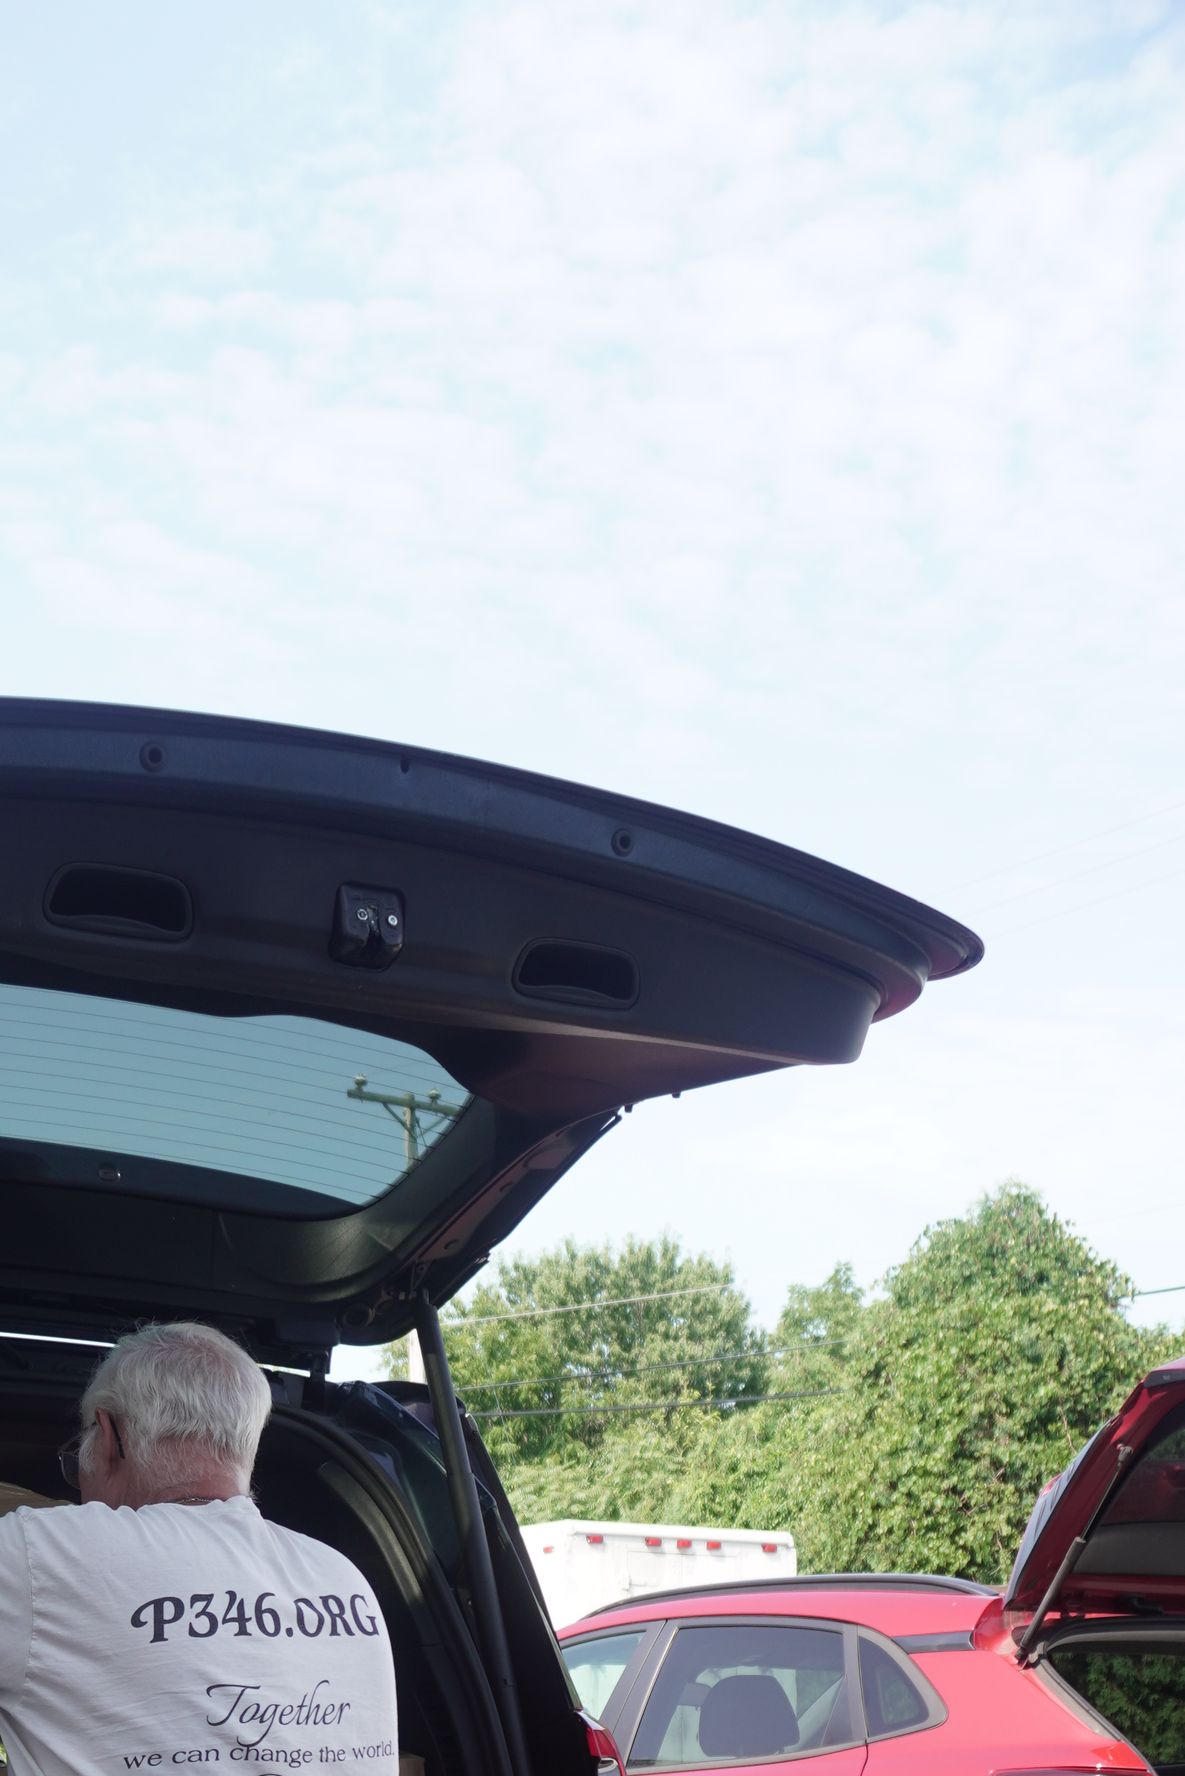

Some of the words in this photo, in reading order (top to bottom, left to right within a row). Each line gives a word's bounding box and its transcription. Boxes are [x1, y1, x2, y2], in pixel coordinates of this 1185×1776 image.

[130, 1590, 380, 1643] P346.ORG
[206, 1679, 351, 1747] Together
[123, 1752, 162, 1769] we
[172, 1748, 220, 1765] can
[229, 1745, 313, 1768] change
[319, 1746, 346, 1763] the
[352, 1740, 395, 1759] world.
